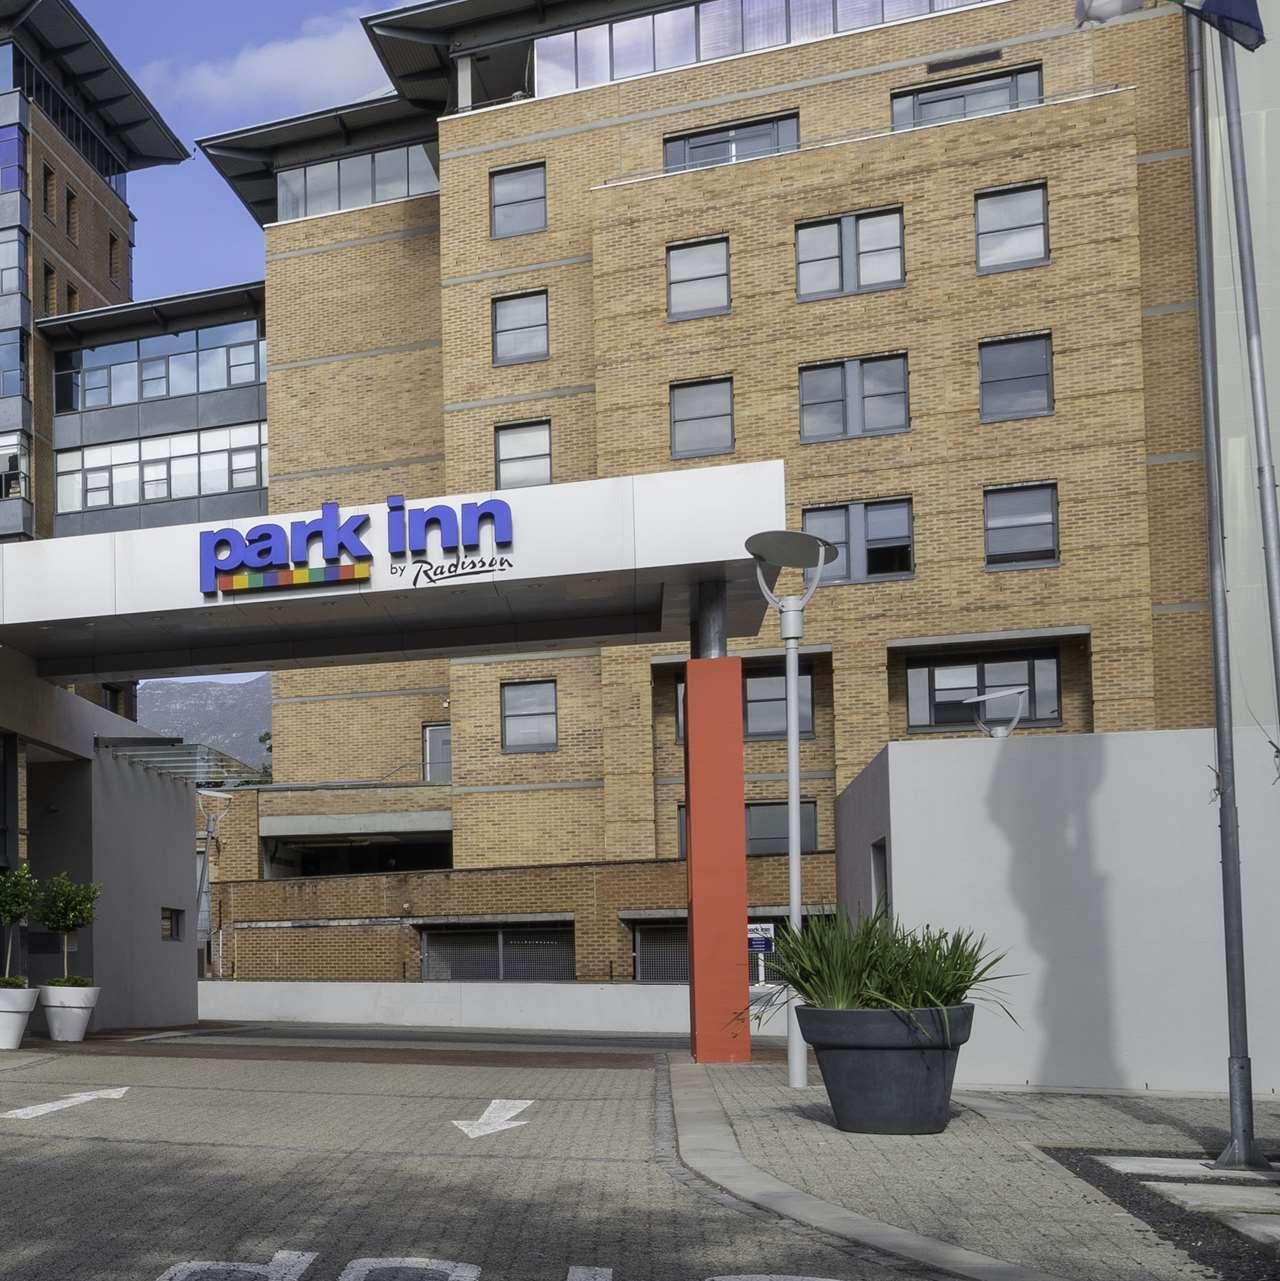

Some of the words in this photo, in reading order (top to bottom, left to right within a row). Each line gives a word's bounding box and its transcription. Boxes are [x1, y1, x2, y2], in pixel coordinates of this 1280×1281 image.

[200, 502, 372, 593] park
[387, 495, 513, 556] inn
[389, 563, 406, 577] by
[412, 553, 513, 587] Radisson
